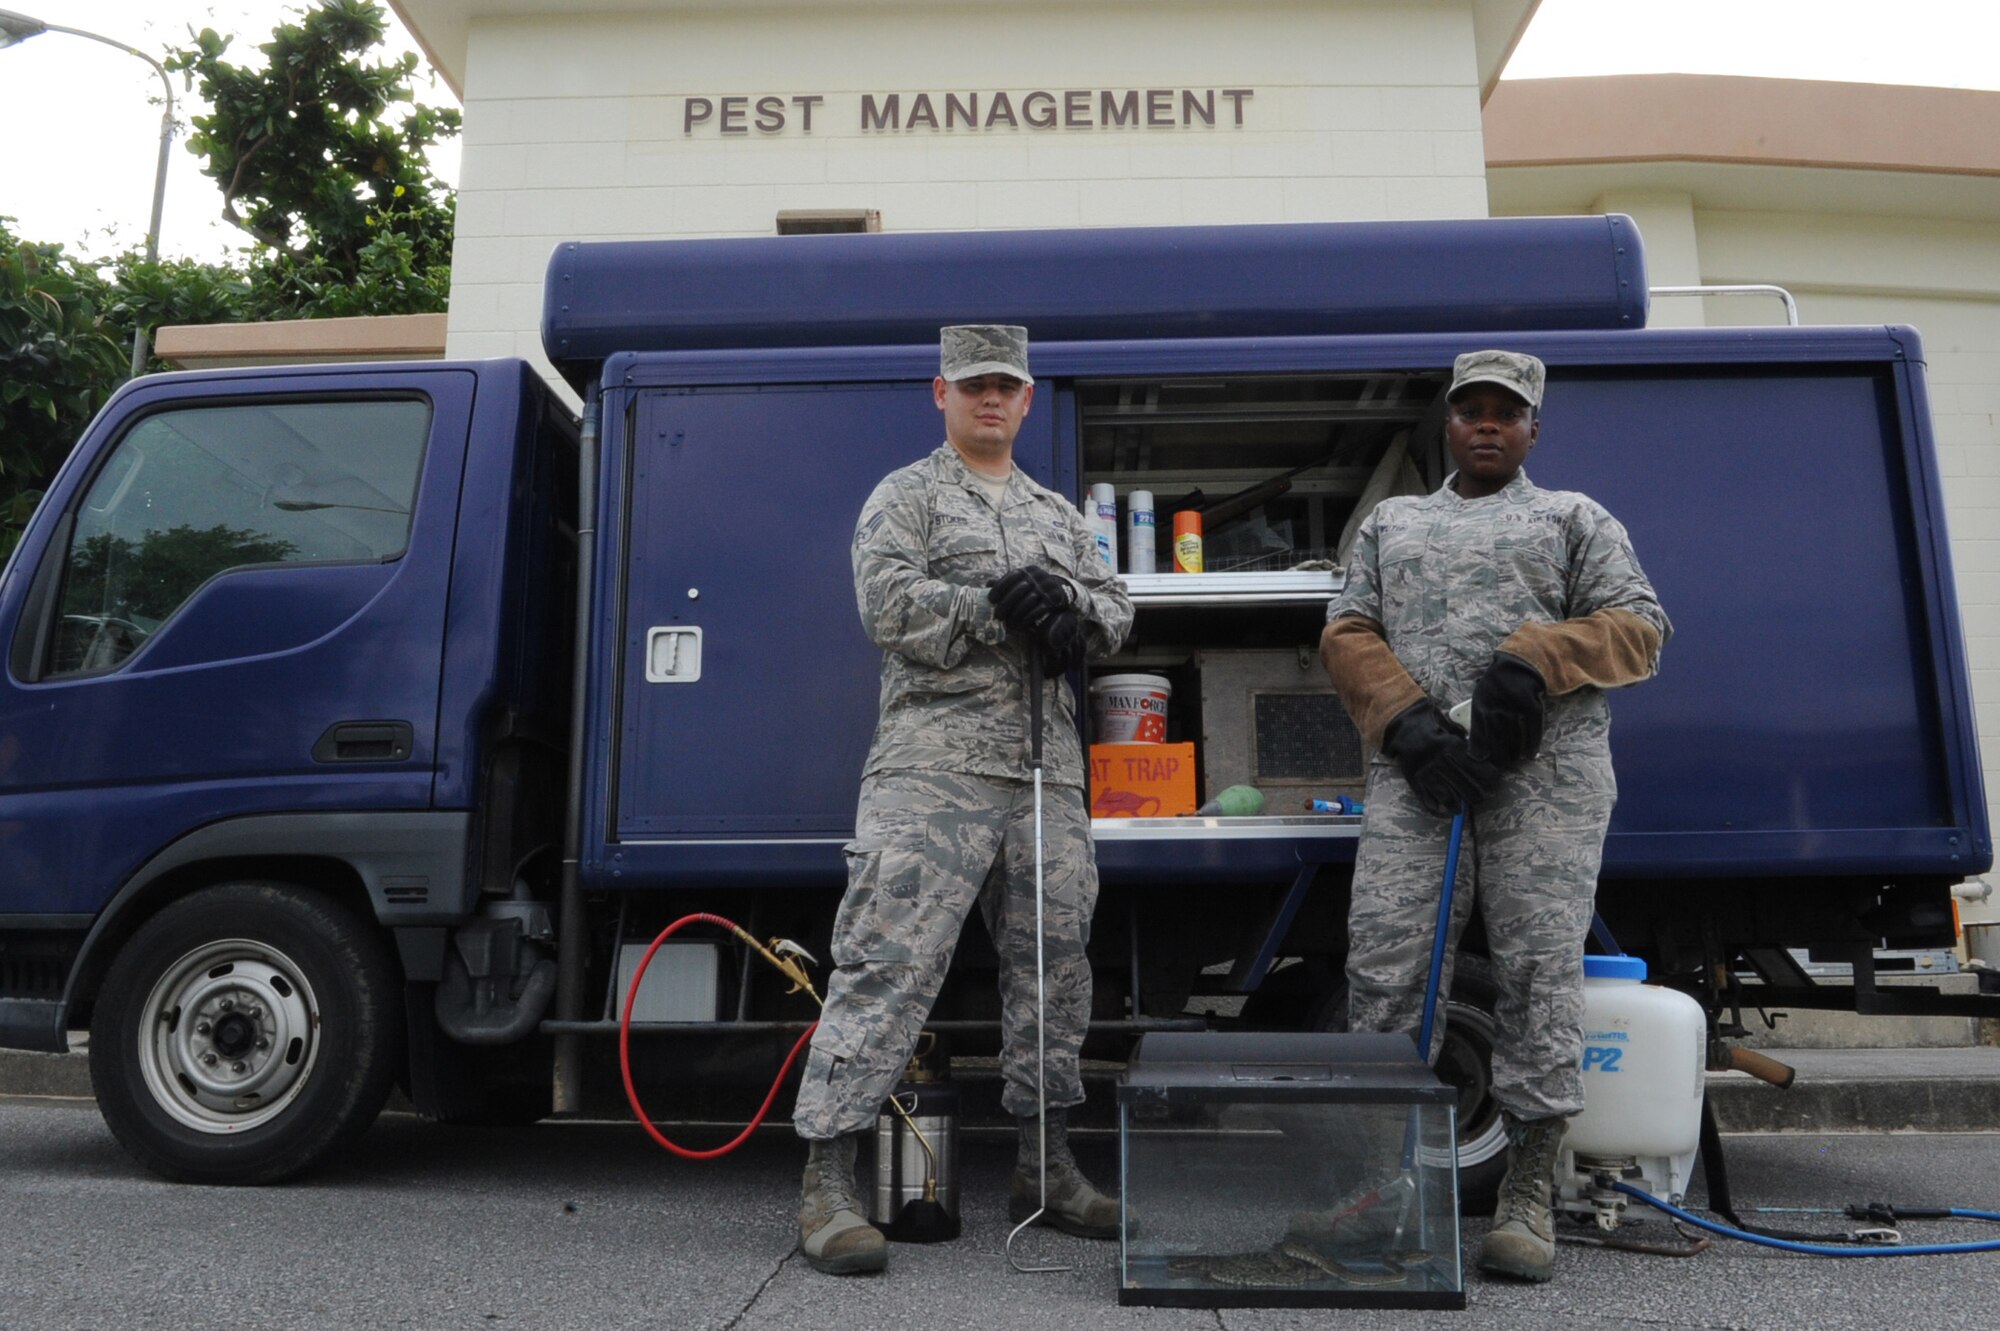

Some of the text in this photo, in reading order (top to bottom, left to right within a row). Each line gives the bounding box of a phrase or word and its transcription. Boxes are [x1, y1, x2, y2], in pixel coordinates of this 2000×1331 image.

[685, 89, 1254, 136] PEST MANAGEMENT
[1546, 513, 1567, 531] FORC
[1123, 757, 1179, 782] TRAP
